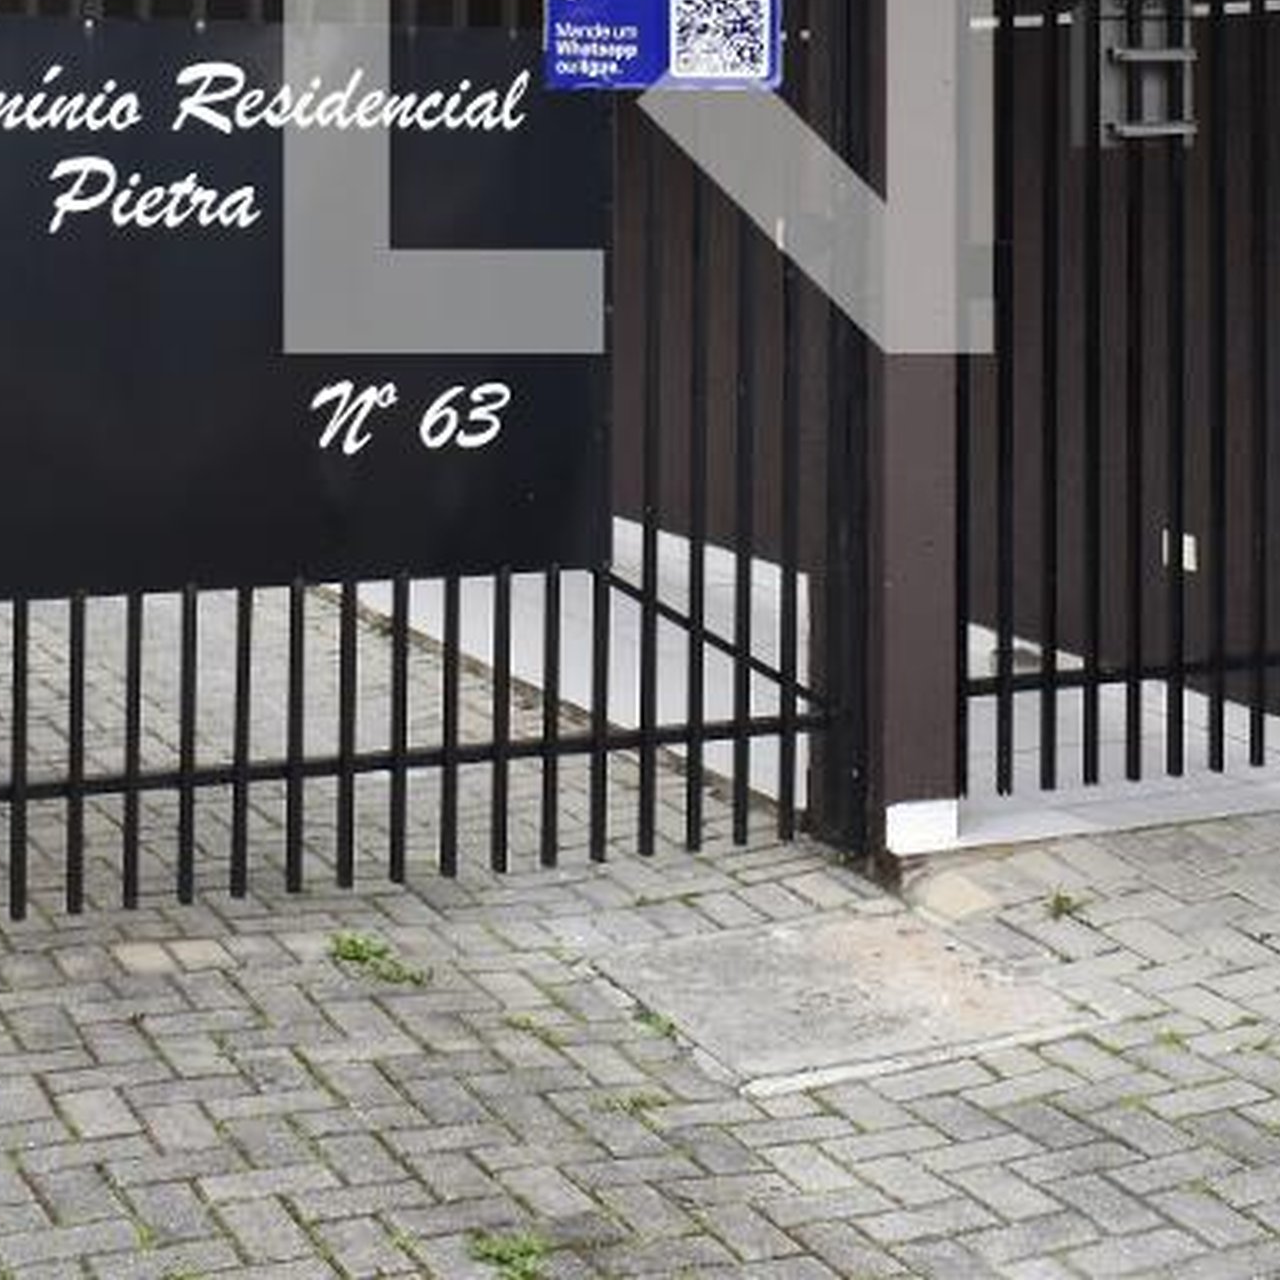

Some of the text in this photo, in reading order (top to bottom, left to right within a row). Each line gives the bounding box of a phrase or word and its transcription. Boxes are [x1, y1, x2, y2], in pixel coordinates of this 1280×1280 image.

[172, 62, 531, 134] Residencial
[48, 155, 262, 234] Pietra
[418, 382, 511, 449] 63
